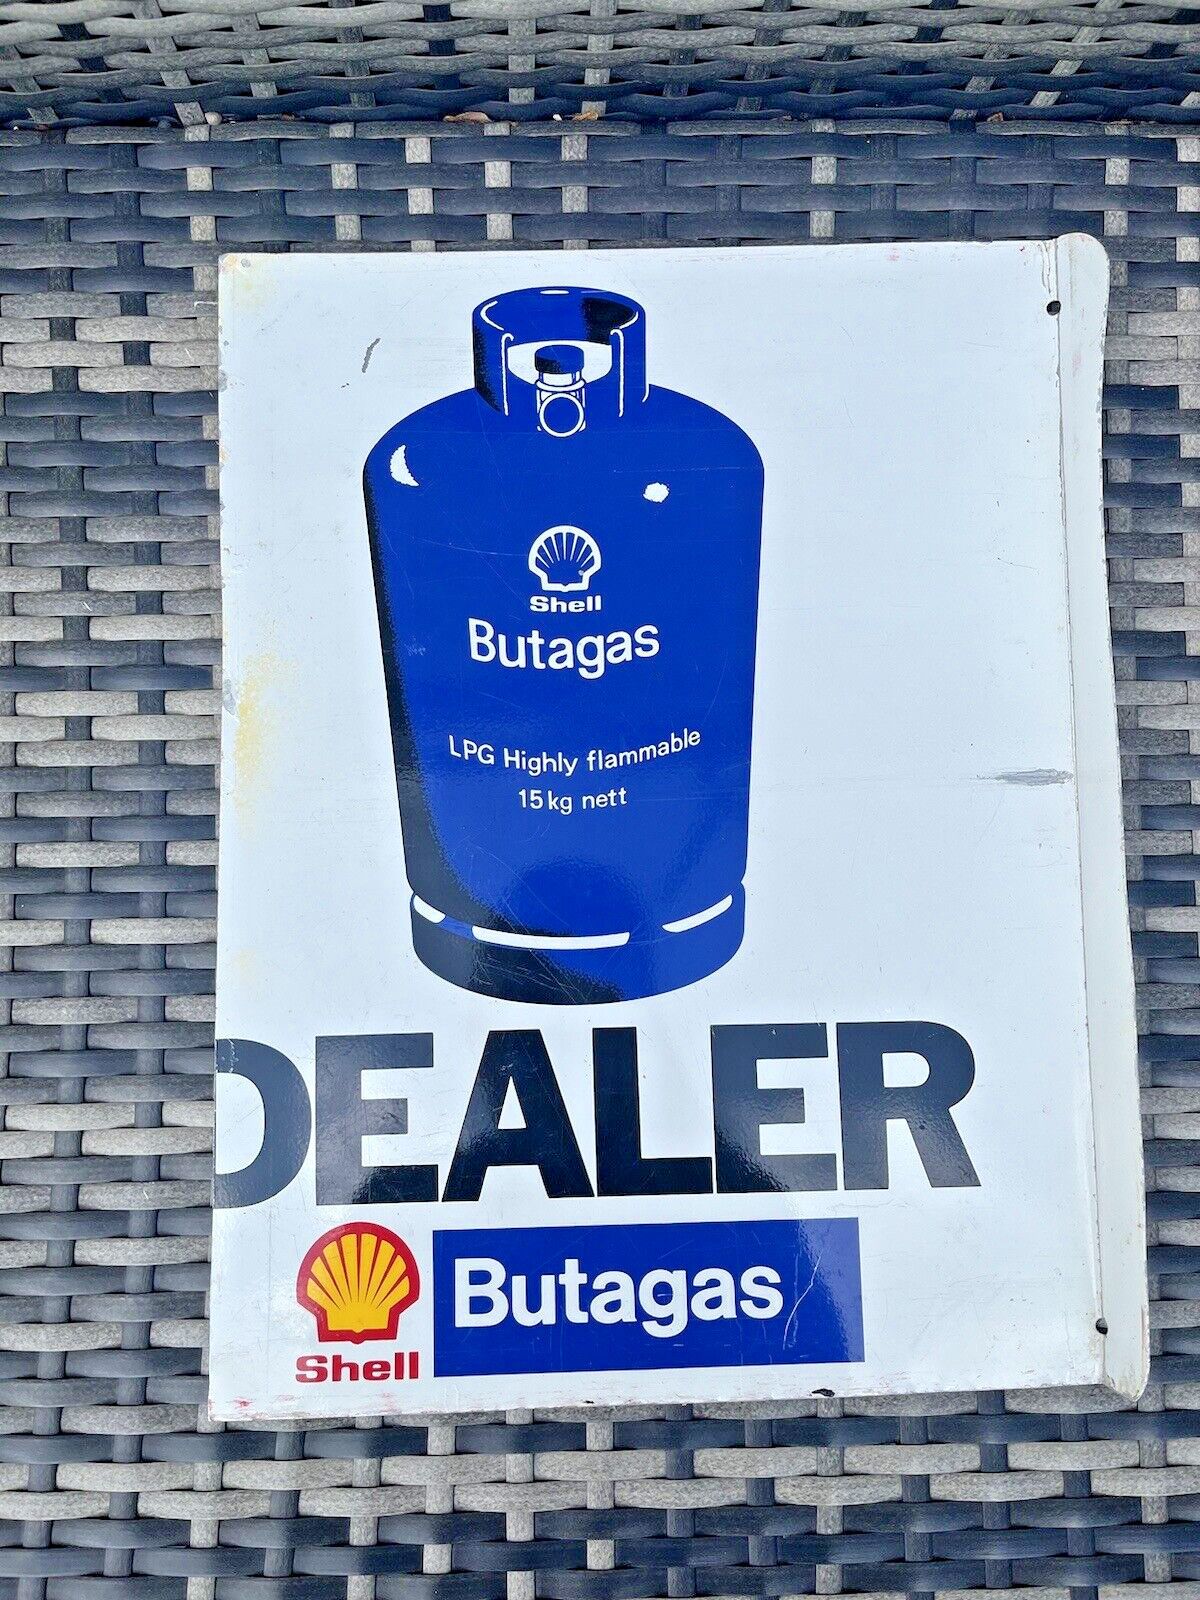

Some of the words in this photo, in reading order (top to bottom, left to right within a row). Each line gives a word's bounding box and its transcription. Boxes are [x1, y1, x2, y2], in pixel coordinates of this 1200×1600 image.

[529, 594, 602, 613] Shell
[467, 617, 660, 680] Butagas
[448, 734, 495, 766] LPG
[503, 748, 578, 777] Highly
[586, 727, 702, 772] flammable
[581, 785, 628, 809] nett
[453, 1257, 784, 1338] Butagas
[295, 1351, 420, 1383] Shell
